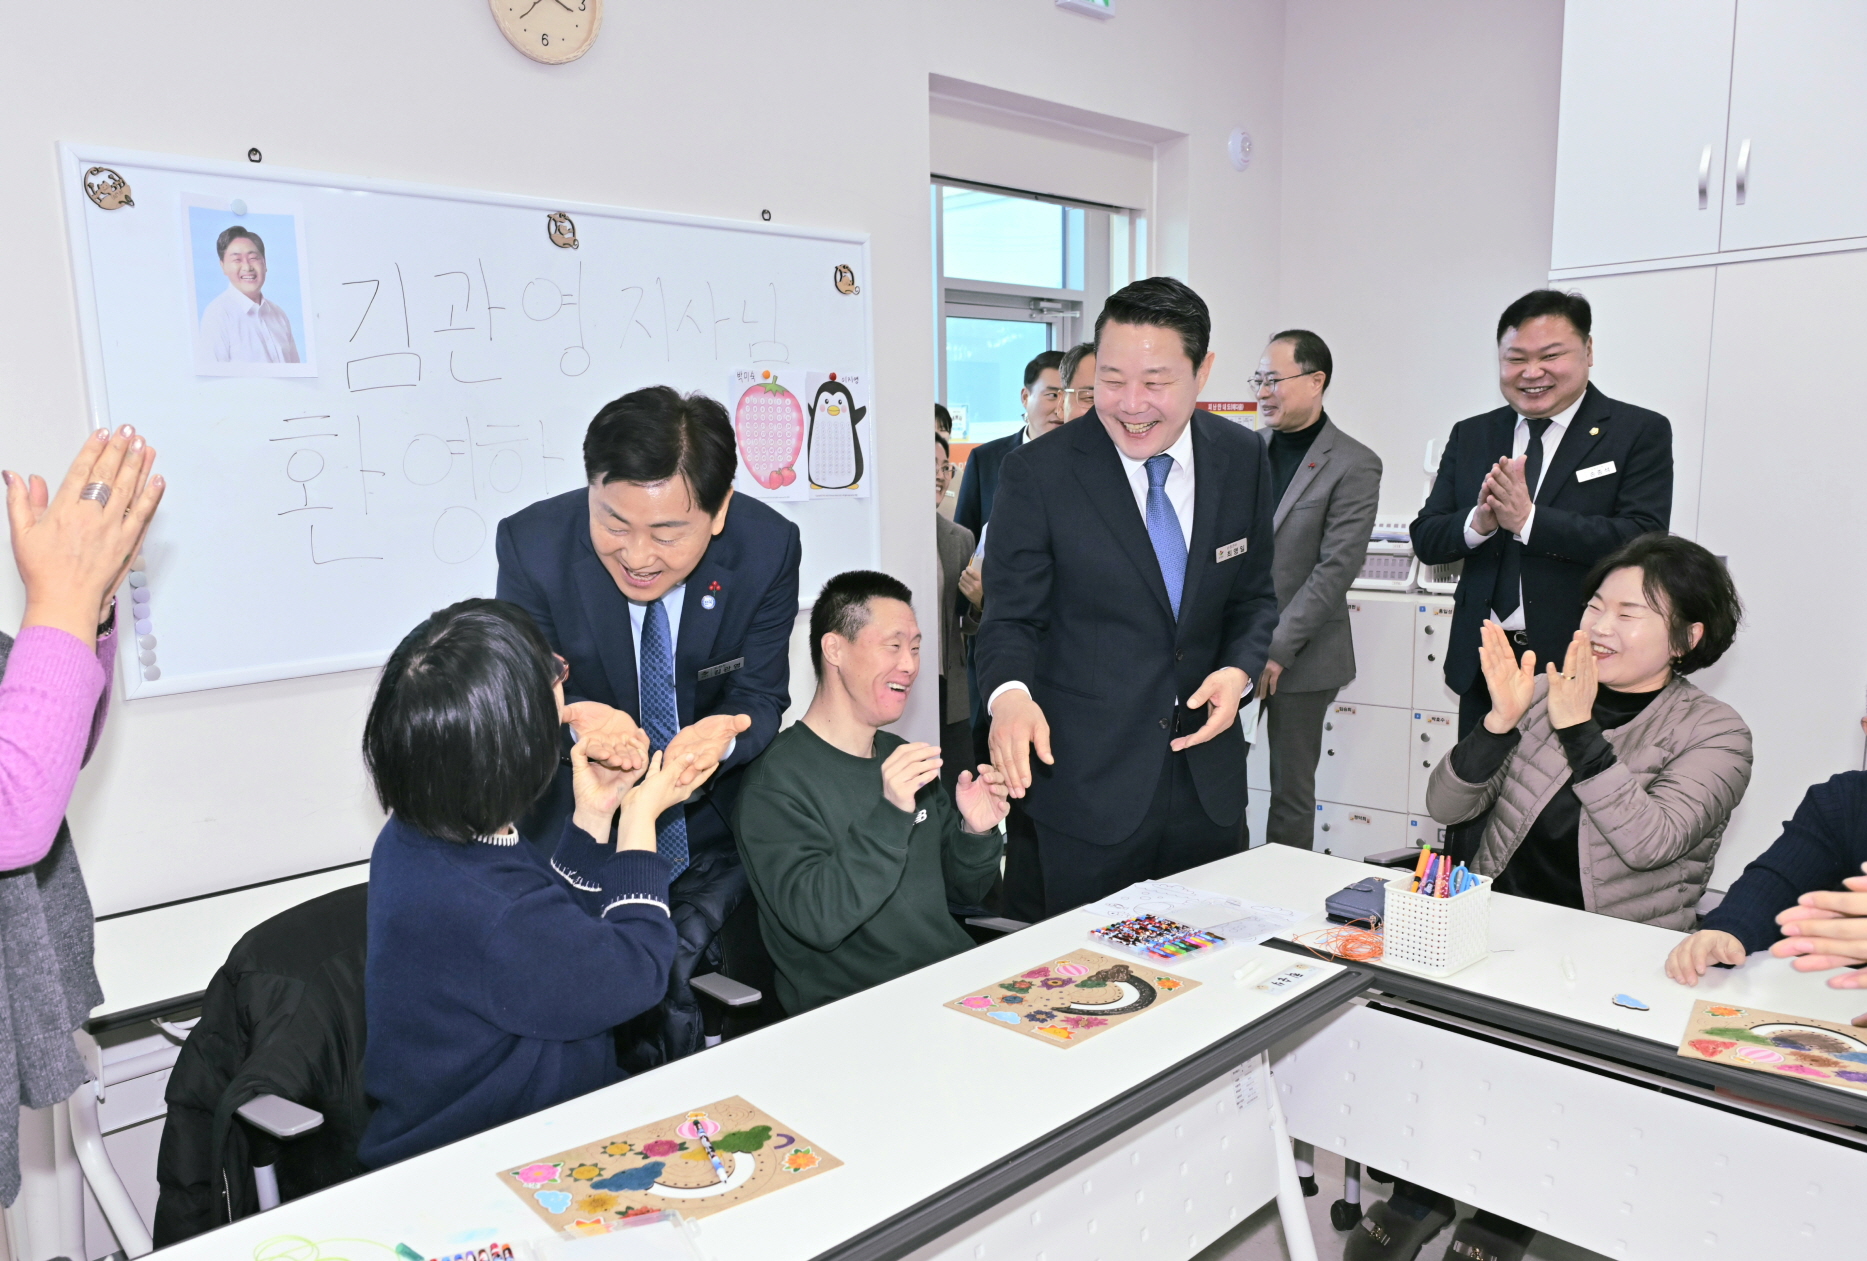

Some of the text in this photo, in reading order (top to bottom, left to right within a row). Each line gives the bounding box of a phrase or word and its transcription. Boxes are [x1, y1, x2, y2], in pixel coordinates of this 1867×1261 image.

[578, 0, 587, 12] 3
[541, 33, 550, 47] 6
[341, 257, 790, 393] 김관영 지사님
